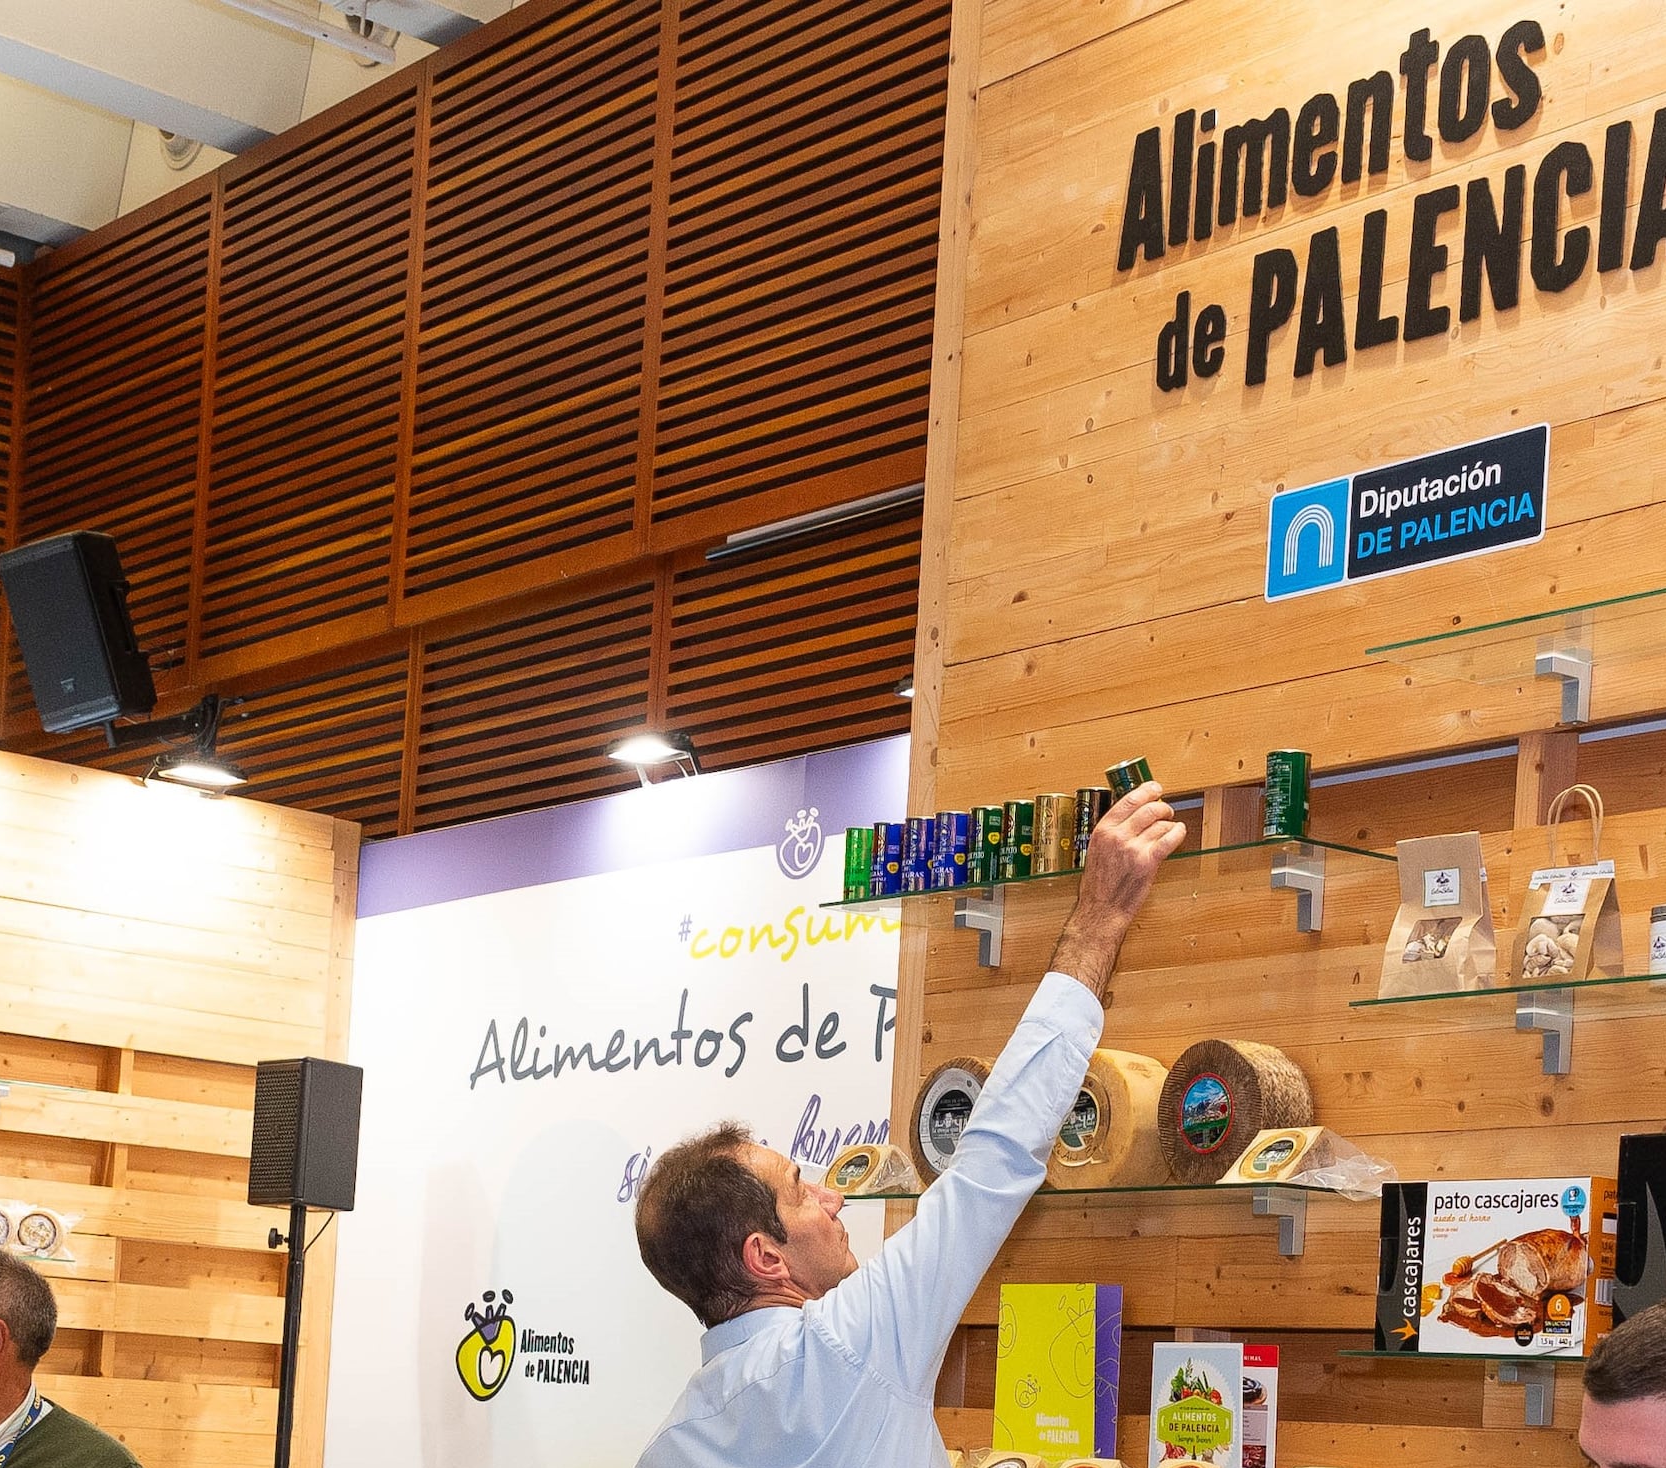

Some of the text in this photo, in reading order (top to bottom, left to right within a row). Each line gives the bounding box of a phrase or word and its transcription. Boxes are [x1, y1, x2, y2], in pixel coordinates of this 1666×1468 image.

[1117, 20, 1546, 272] Alimentos
[1156, 290, 1225, 393] de
[1359, 461, 1502, 519] Diputación
[1357, 492, 1536, 560] DE PALENCIA
[470, 988, 753, 1090] Alimentos
[776, 983, 847, 1064] de
[1434, 1194, 1471, 1215] pato
[1477, 1189, 1559, 1214] cascajares
[1402, 1216, 1423, 1318] cascajares
[1554, 1298, 1563, 1313] 6
[520, 1328, 575, 1355] Alimentos
[524, 1358, 590, 1386] de PALENCIA
[1169, 1423, 1220, 1434] DE PALENCIA
[1172, 1411, 1217, 1423] ALIMENTOS
